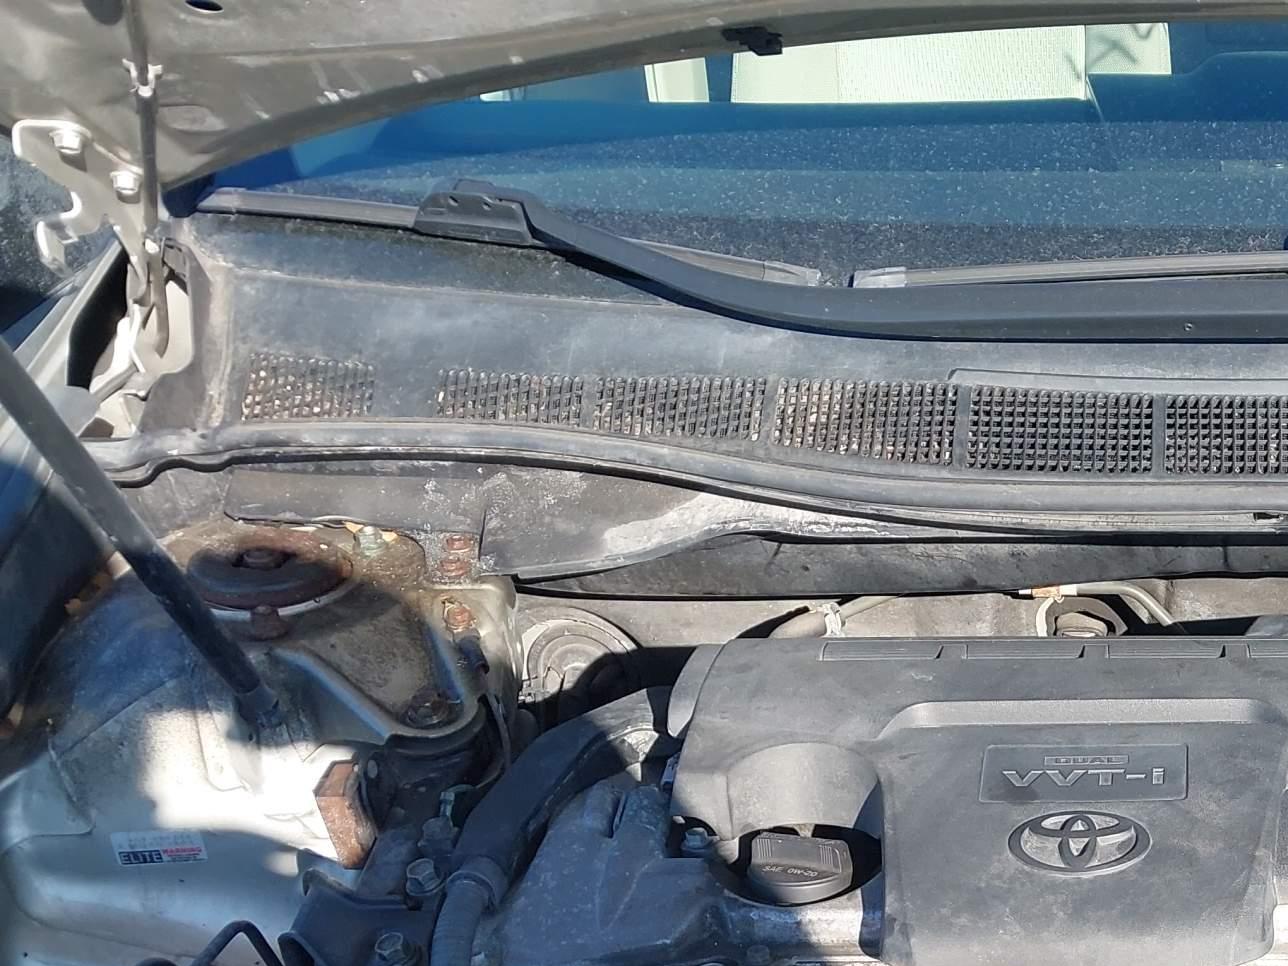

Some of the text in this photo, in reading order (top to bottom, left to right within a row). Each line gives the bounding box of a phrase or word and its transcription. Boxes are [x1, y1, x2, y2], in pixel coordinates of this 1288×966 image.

[1002, 767, 1165, 787] VVT-i
[120, 852, 162, 864] ELITE
[762, 865, 818, 877] SAE 0W-20
